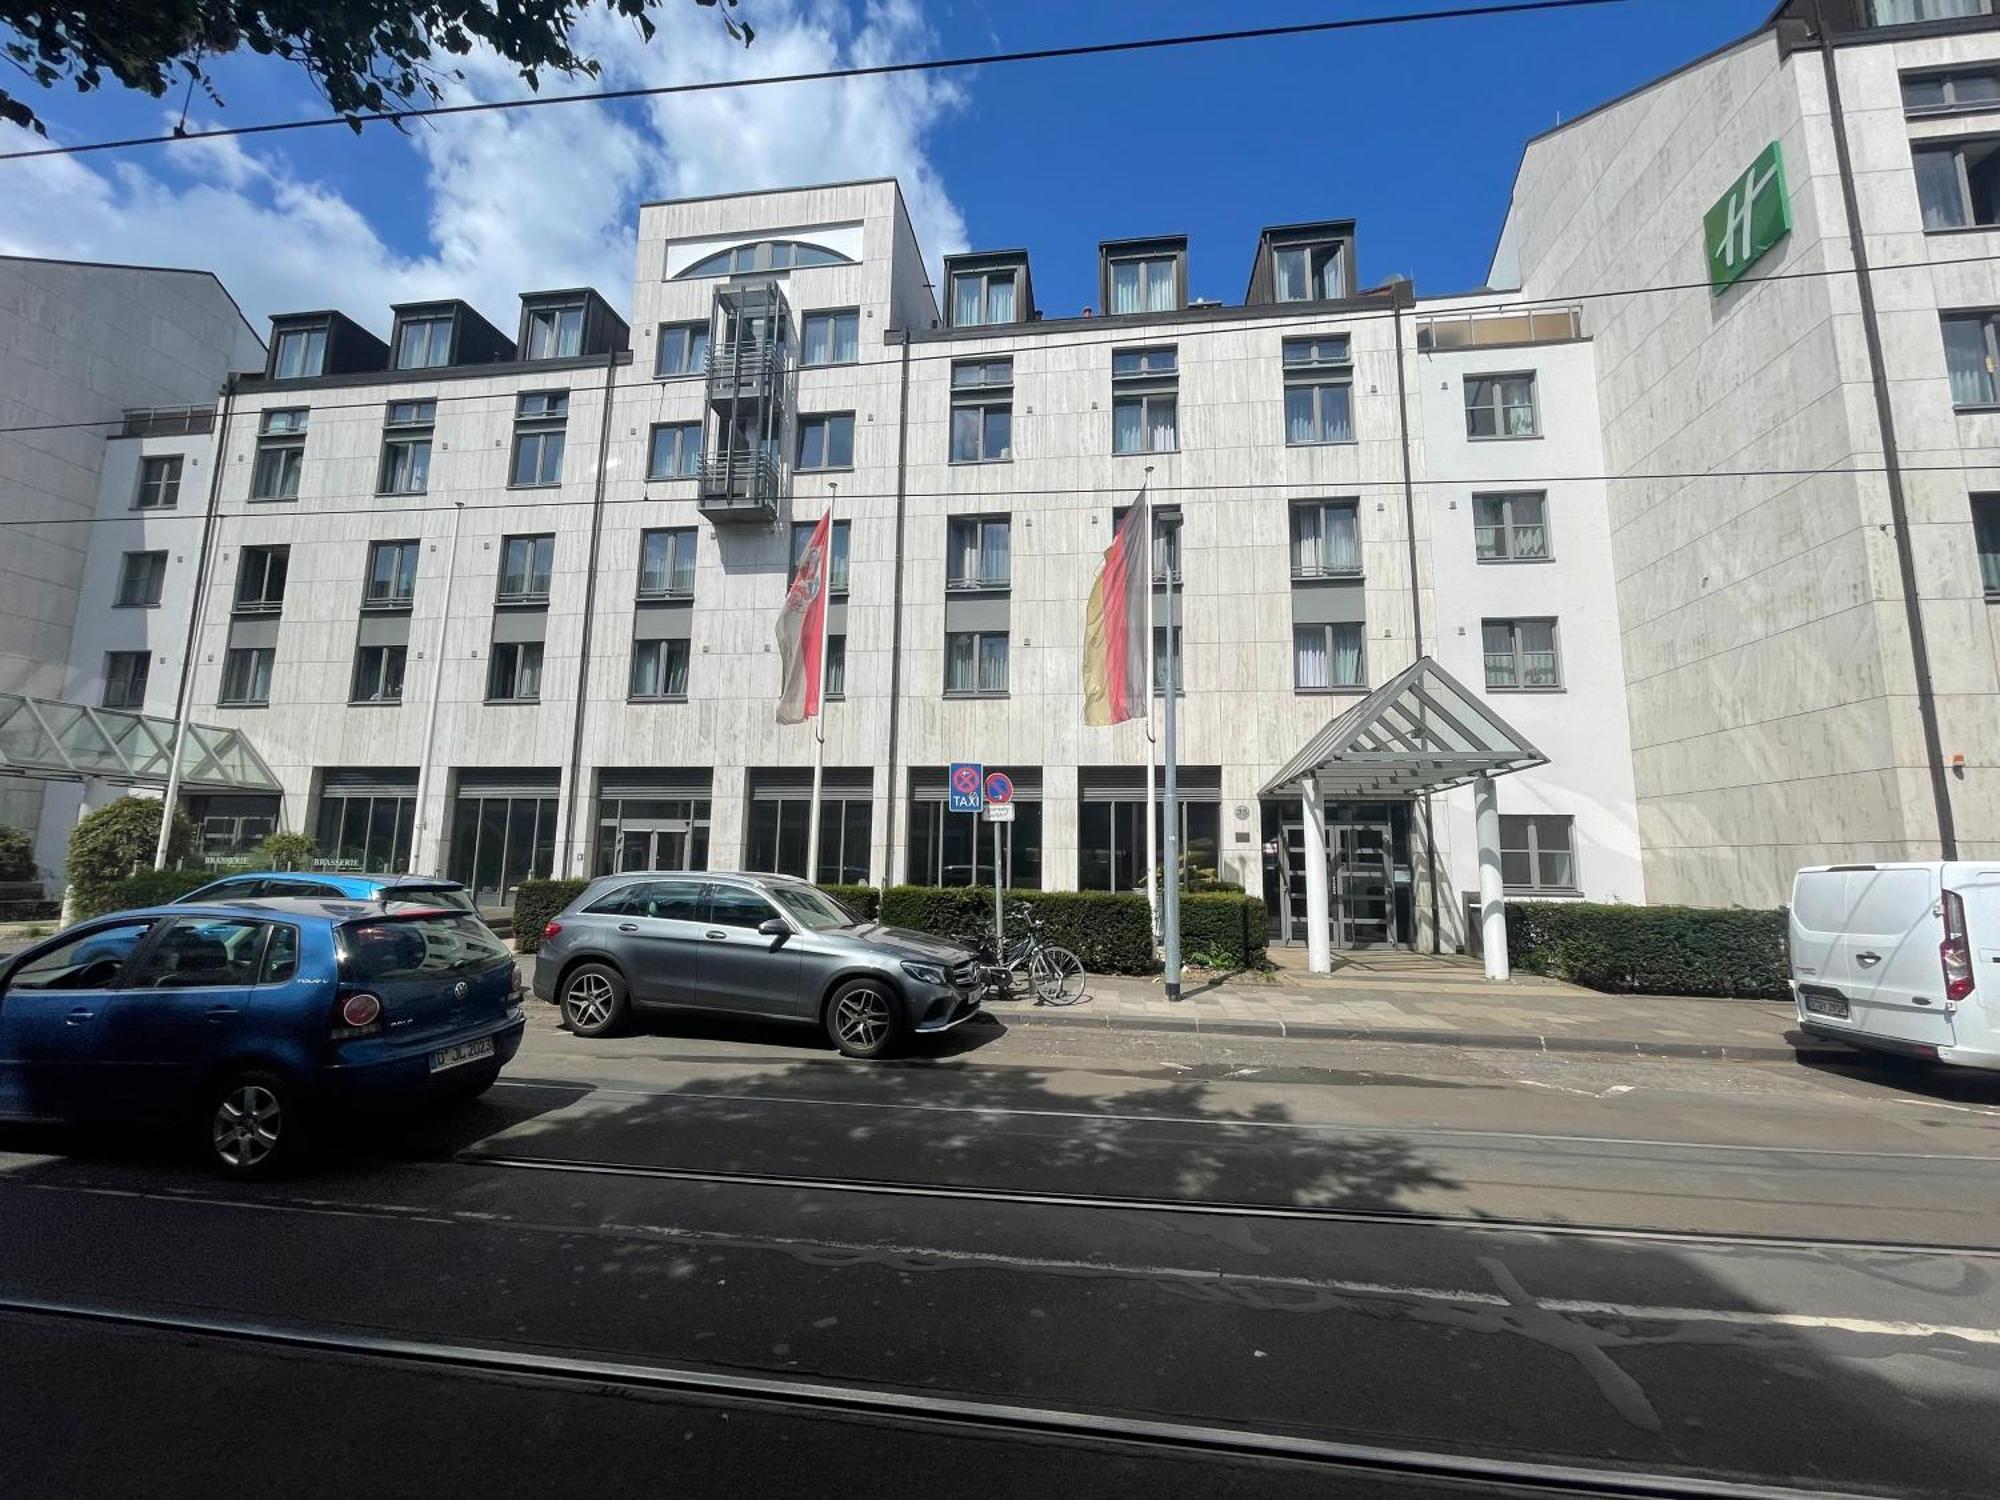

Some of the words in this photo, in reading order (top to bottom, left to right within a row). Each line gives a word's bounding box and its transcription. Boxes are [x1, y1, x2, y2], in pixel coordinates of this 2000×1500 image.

[953, 795, 980, 807] TAXI
[204, 856, 248, 865] BRASSERIE
[313, 858, 360, 866] BRASSERIE
